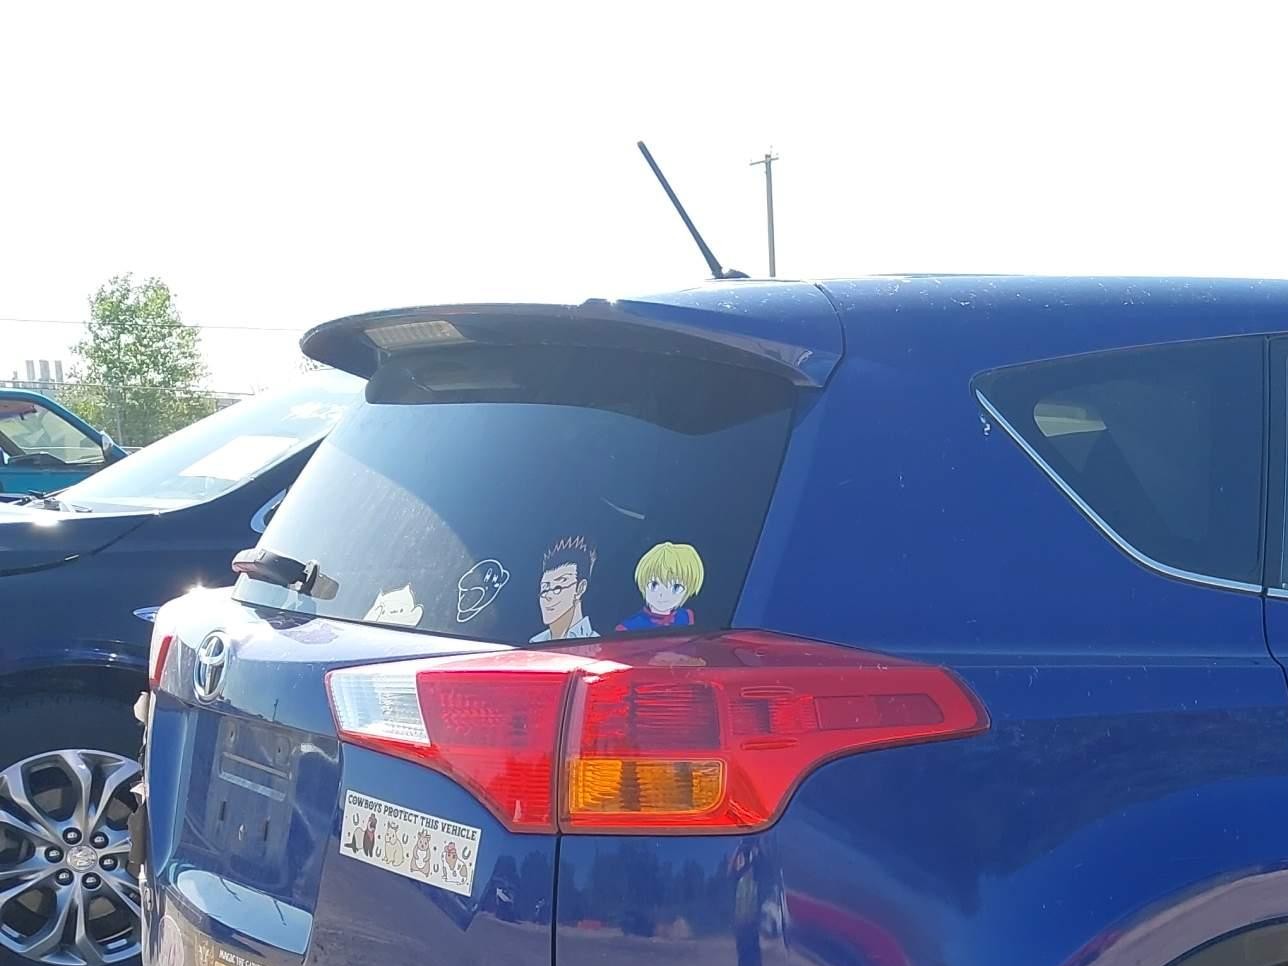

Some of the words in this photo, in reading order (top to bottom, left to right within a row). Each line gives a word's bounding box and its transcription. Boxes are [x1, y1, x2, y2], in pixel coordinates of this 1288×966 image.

[348, 794, 382, 814] COWBOYS
[383, 805, 418, 825] PROTECT
[420, 816, 439, 830] THIS
[441, 821, 477, 841] VEHICLE
